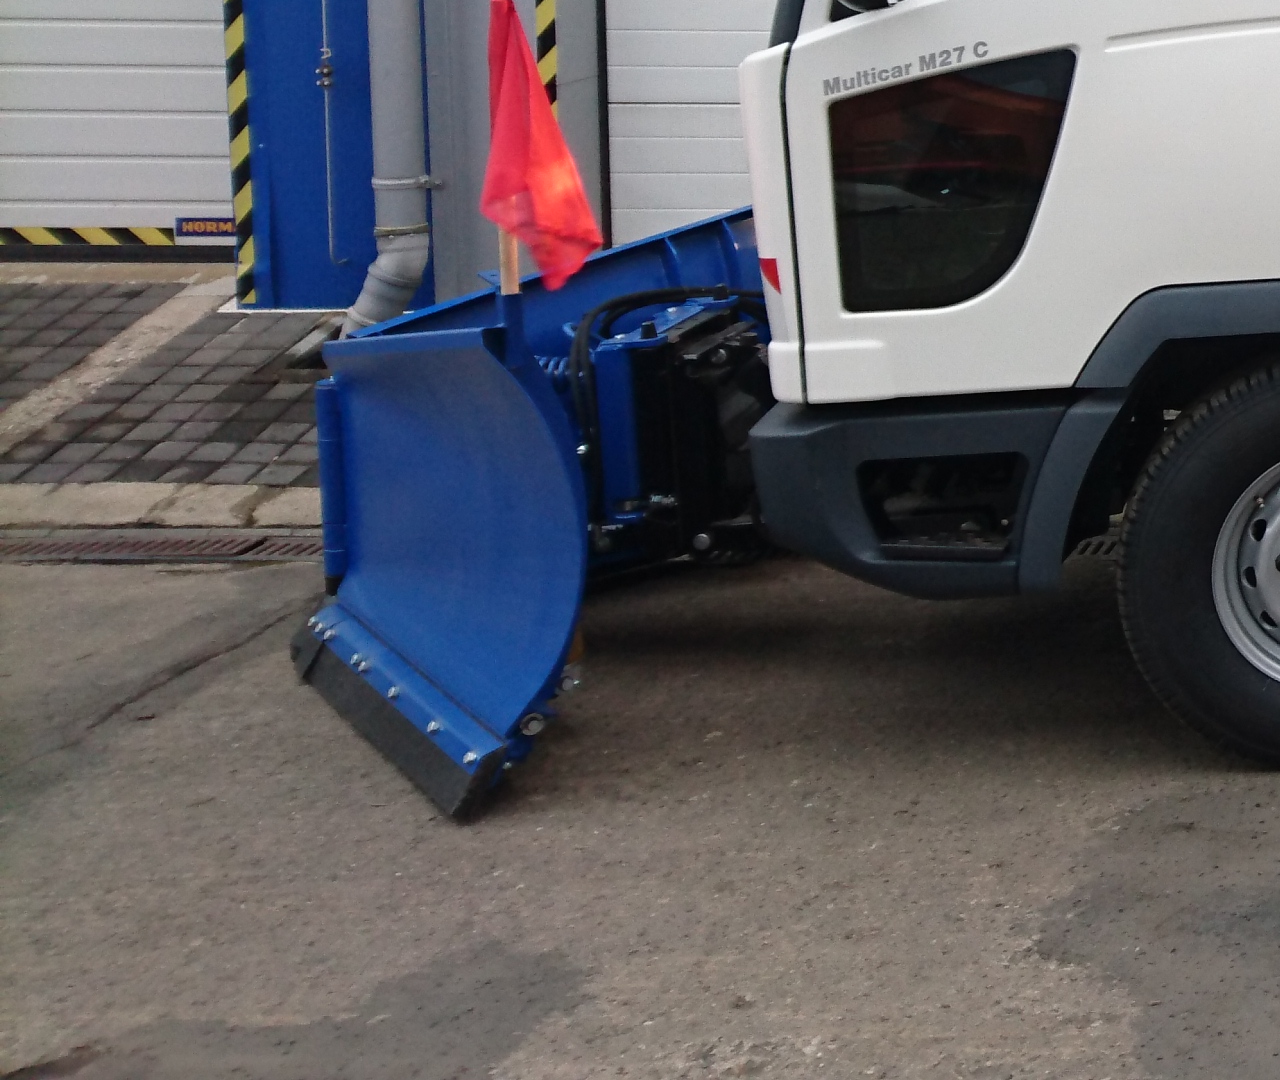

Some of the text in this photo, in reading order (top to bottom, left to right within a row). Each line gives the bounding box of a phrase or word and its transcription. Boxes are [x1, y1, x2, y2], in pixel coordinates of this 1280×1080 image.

[822, 41, 988, 96] Multicar M27 C
